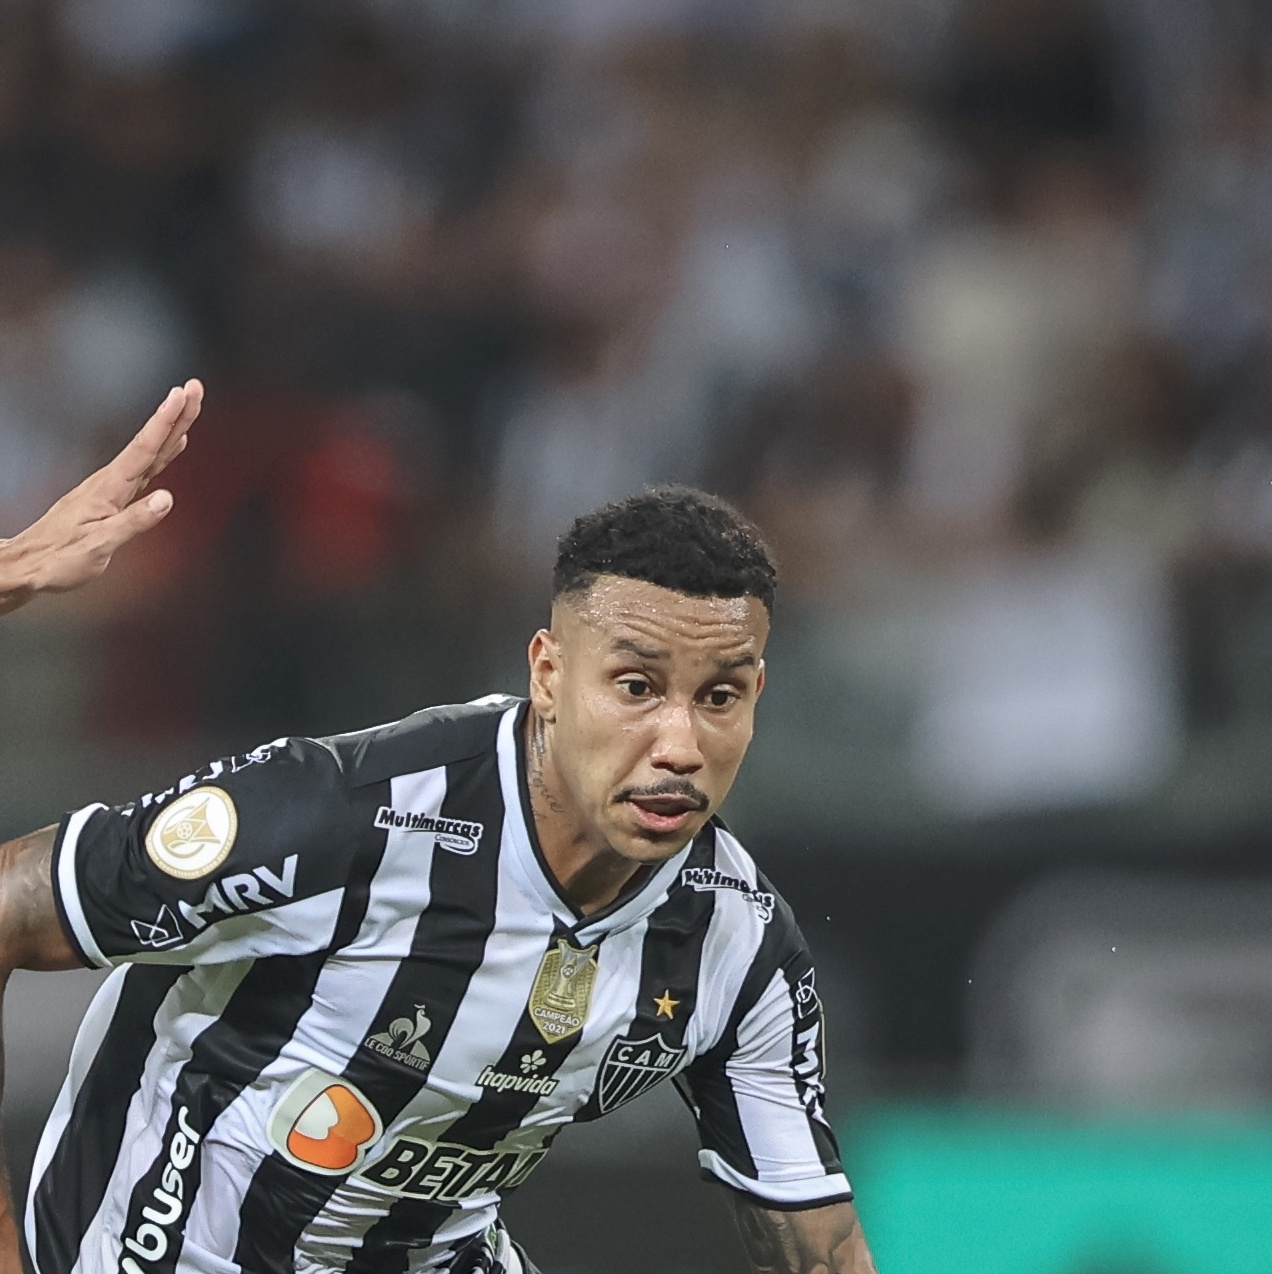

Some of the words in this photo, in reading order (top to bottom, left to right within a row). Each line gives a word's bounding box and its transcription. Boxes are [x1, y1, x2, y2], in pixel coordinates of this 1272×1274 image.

[378, 809, 481, 838] Multimarcas
[178, 853, 299, 930] MRV
[542, 1021, 566, 1034] 2021
[364, 1037, 377, 1049] LE
[393, 1050, 430, 1071] SPORTIF
[617, 1046, 675, 1068] CAM
[478, 1066, 559, 1096] hapvida
